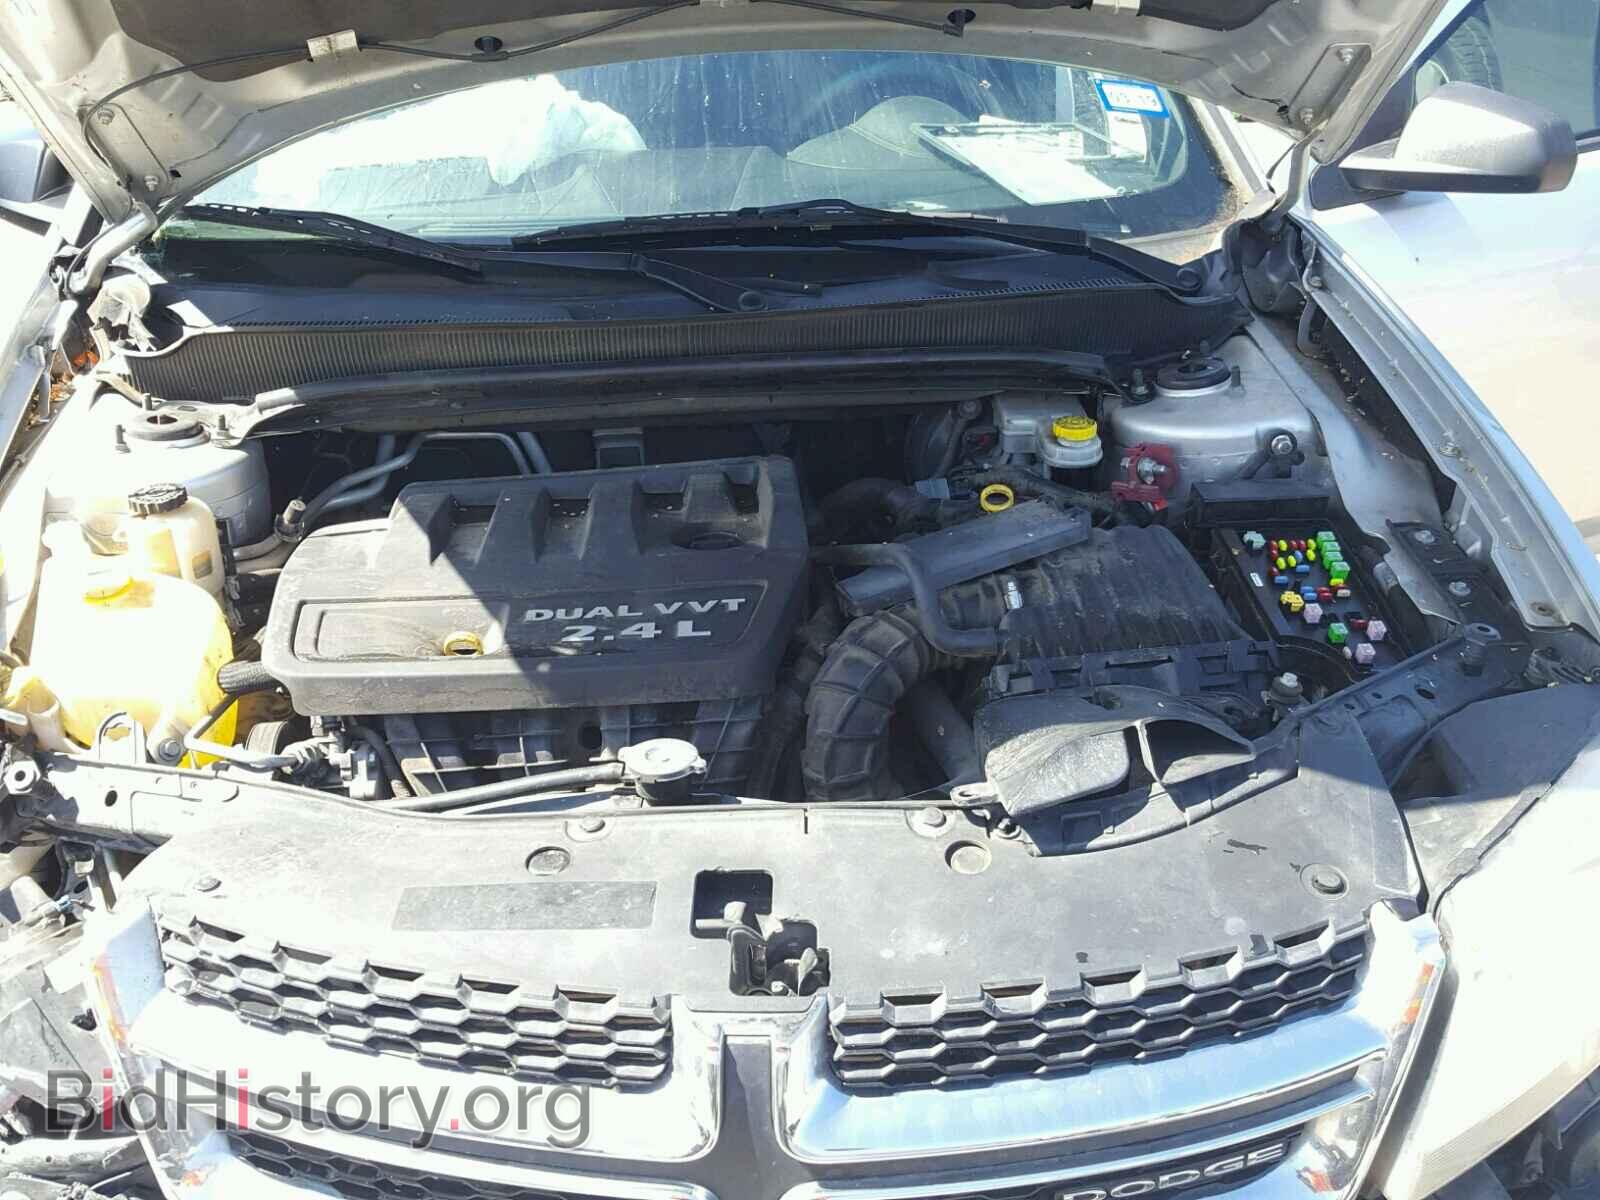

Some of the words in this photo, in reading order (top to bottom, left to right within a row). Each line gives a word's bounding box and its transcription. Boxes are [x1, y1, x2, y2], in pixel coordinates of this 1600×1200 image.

[524, 605, 643, 622] DUAL
[654, 598, 746, 615] VVT
[1062, 1143, 1284, 1200] DODGE
